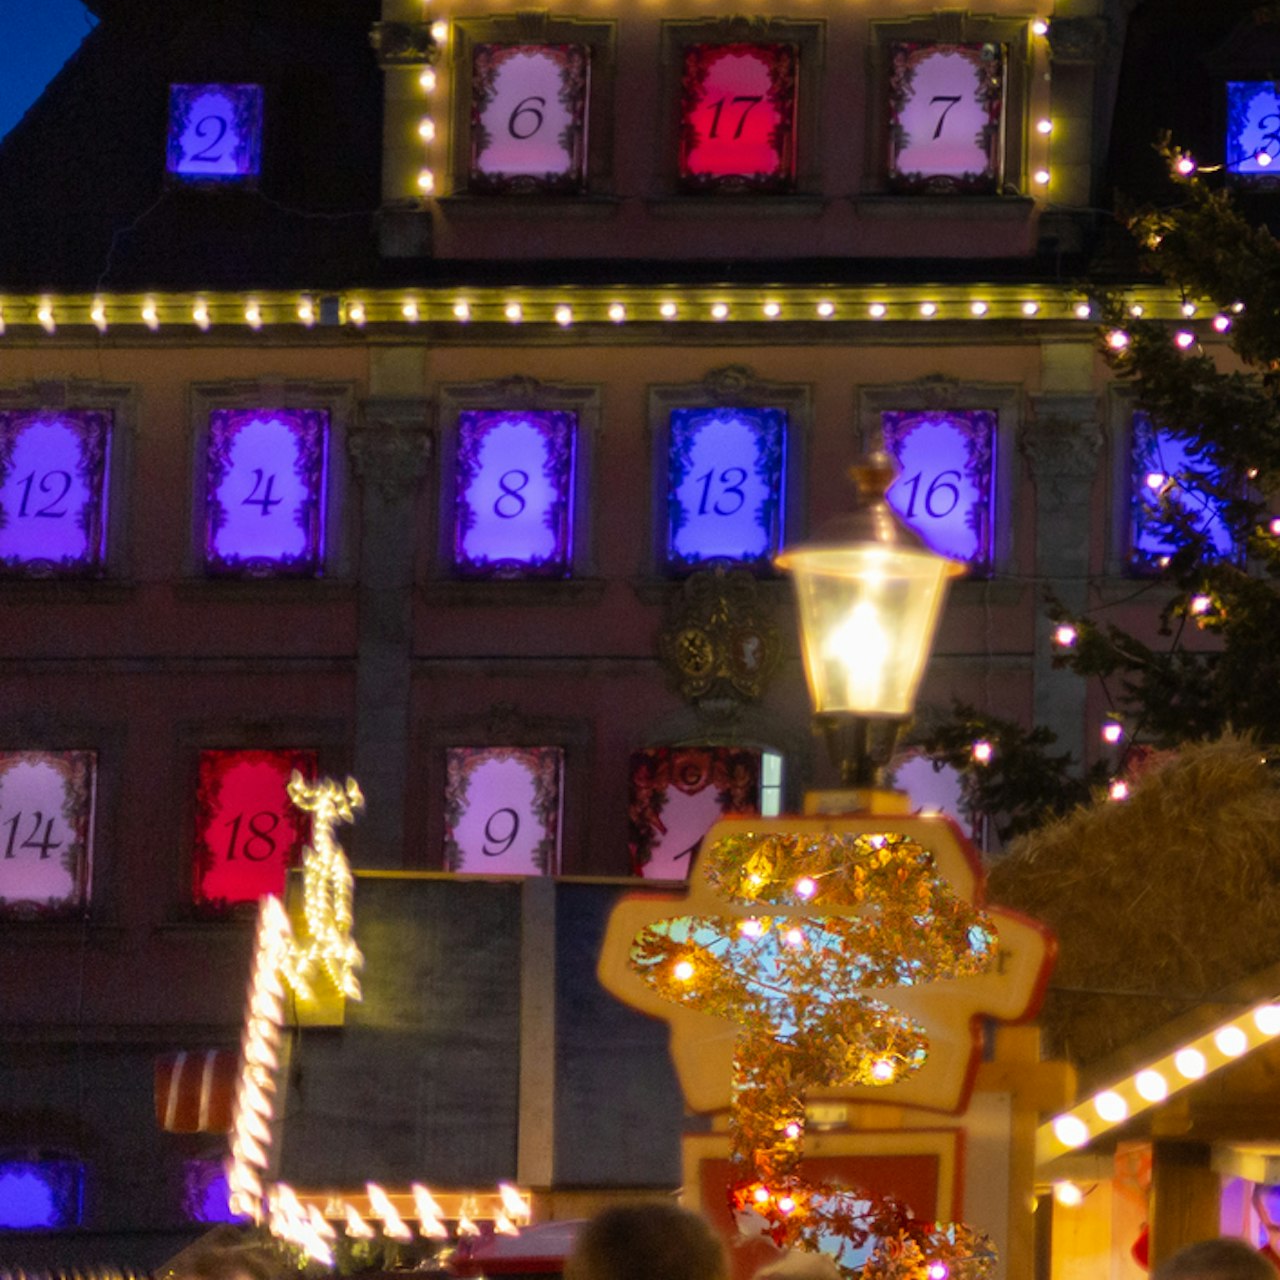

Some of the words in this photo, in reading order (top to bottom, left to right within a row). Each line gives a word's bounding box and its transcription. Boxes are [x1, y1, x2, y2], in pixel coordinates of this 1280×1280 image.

[191, 115, 227, 161] 2
[508, 96, 545, 140] 6
[705, 95, 762, 139] 17
[930, 95, 961, 139] 7
[16, 471, 72, 518] 12
[241, 468, 282, 516] 4
[494, 469, 529, 518] 8
[697, 467, 747, 516] 13
[902, 470, 961, 518] 16
[4, 810, 63, 860] 14
[226, 812, 279, 861] 18
[483, 808, 520, 857] 9
